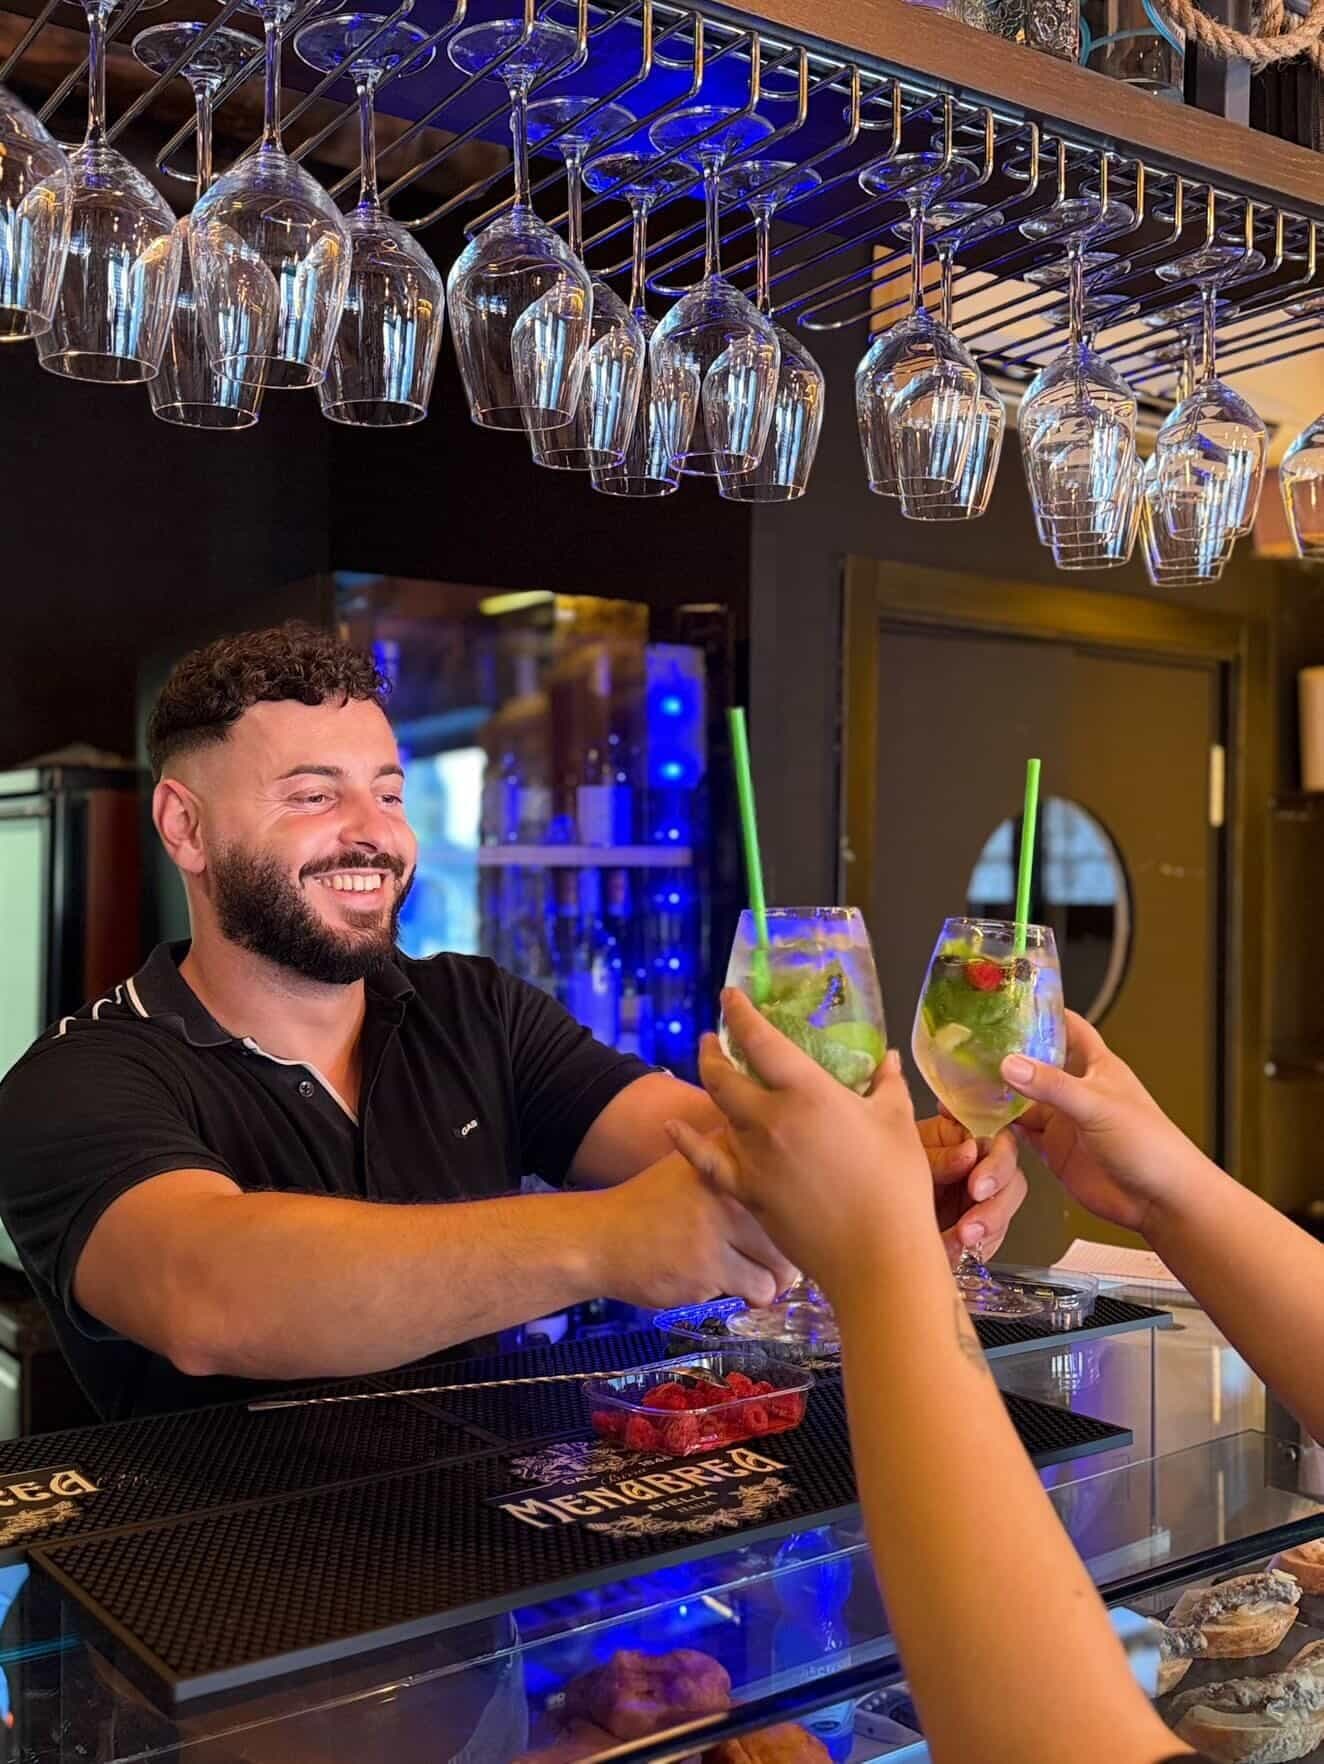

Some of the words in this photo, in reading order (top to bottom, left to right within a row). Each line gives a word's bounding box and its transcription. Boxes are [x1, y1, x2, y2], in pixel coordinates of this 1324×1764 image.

[0, 1470, 104, 1507] EA
[500, 1447, 789, 1529] MENABREA
[648, 1491, 719, 1511] BIELLA
